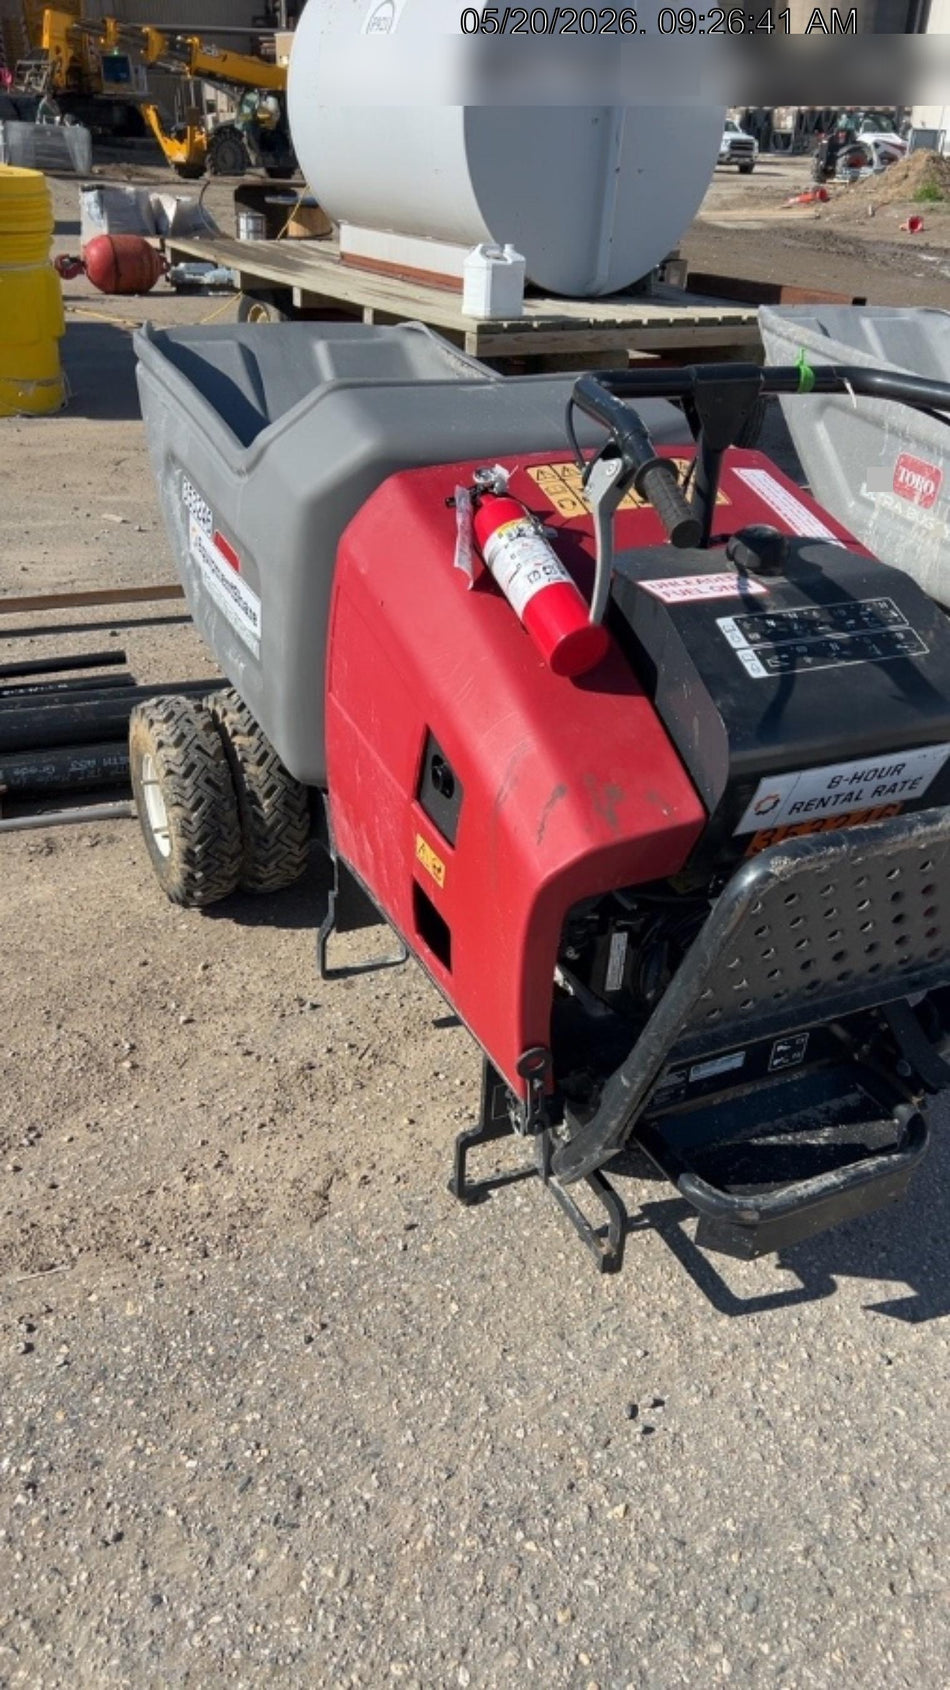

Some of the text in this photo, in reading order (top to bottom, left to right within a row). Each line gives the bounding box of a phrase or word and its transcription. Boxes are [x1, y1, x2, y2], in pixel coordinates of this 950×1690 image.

[898, 465, 936, 494] TORO
[661, 586, 708, 598] FUEL
[826, 762, 906, 790] 8-HOUR
[788, 776, 924, 816] RENTAL RATE
